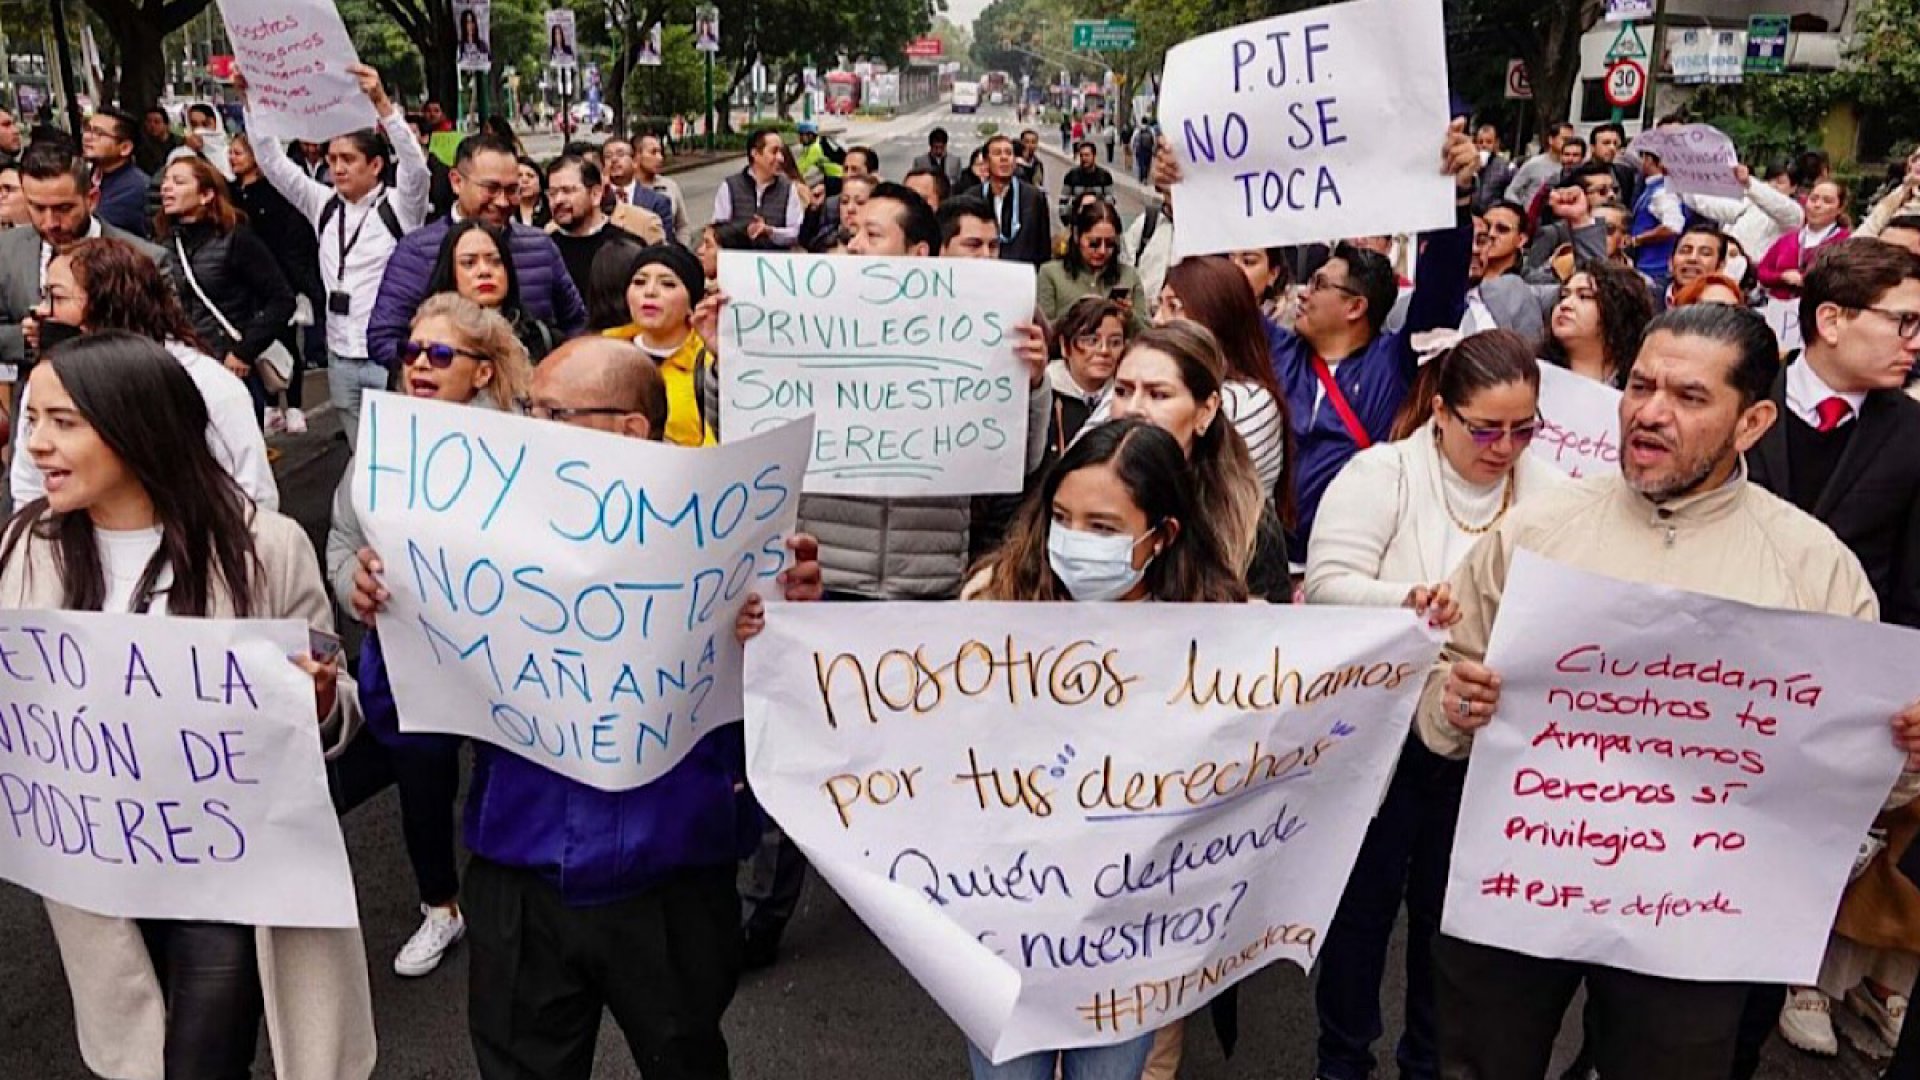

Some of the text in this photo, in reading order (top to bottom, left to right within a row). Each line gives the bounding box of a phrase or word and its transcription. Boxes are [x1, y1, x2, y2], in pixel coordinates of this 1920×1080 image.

[1232, 24, 1332, 93] P.J.F.
[1615, 70, 1635, 87] 30
[1183, 97, 1347, 163] NO SE
[1234, 165, 1342, 217] TOCA
[757, 256, 956, 305] NO SON
[730, 303, 1002, 349] PRIVILEGIOS
[732, 370, 1012, 410] SON NUESTROS
[752, 418, 1006, 462] ERECHOS
[368, 401, 787, 547] HOY SOMOS
[408, 535, 785, 641] NOSOTROS
[124, 642, 162, 697] A
[191, 645, 258, 709] LA
[418, 614, 716, 704] MAÑANA
[813, 634, 1417, 728] nosotr@s luchamos
[1555, 644, 1824, 709] Ciudadanía
[1547, 687, 1777, 736] nosotros te
[180, 729, 260, 784] DE
[1531, 721, 1765, 775] Amparamos
[820, 763, 924, 829] por
[955, 747, 1052, 818] tus
[1513, 768, 1676, 805] Derechos
[0, 772, 246, 865] PODERES
[1504, 815, 1746, 865] Privilegios no
[1094, 806, 1307, 899] defiende
[1020, 880, 1249, 969] nuestros?
[1480, 872, 1585, 909] #PJF
[1620, 891, 1742, 927] defiende
